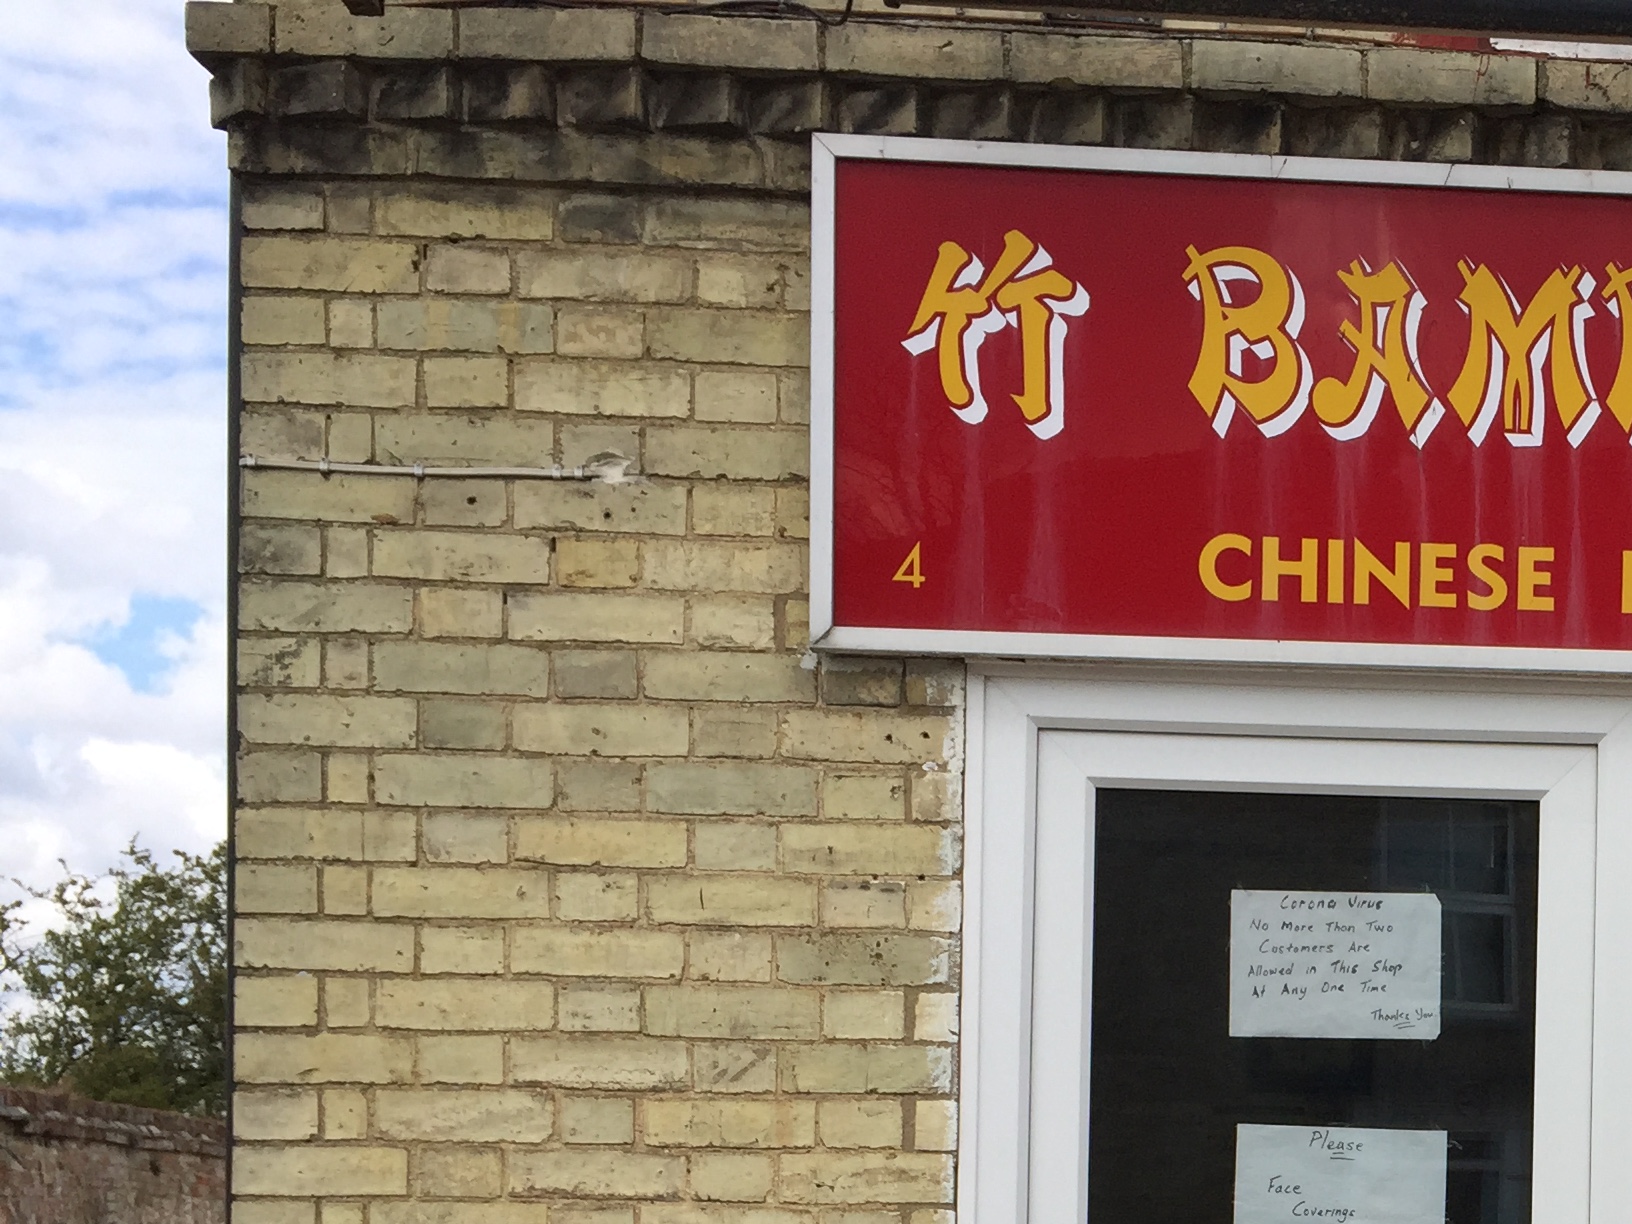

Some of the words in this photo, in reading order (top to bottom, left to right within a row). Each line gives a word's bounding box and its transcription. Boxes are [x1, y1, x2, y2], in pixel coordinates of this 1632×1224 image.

[902, 229, 1090, 441] 竹
[892, 541, 926, 589] 4
[1198, 532, 1556, 612] CHINESE
[1280, 895, 1336, 911] Corona
[1348, 895, 1384, 912] Virus
[1249, 918, 1269, 931] No
[1280, 920, 1314, 933] More
[1325, 921, 1356, 934] Than
[1365, 919, 1394, 933] Two
[1347, 941, 1371, 953] Are
[1247, 962, 1295, 978] Allowed
[1305, 964, 1317, 974] in
[1330, 959, 1359, 975] This
[1371, 959, 1404, 977] Shop
[1251, 984, 1267, 999] At
[1280, 983, 1308, 1000] Any
[1320, 981, 1345, 994] One
[1360, 979, 1388, 993] Time
[1308, 1130, 1364, 1152] Please
[1267, 1175, 1303, 1195] Face
[1291, 1201, 1356, 1223] Coverings
